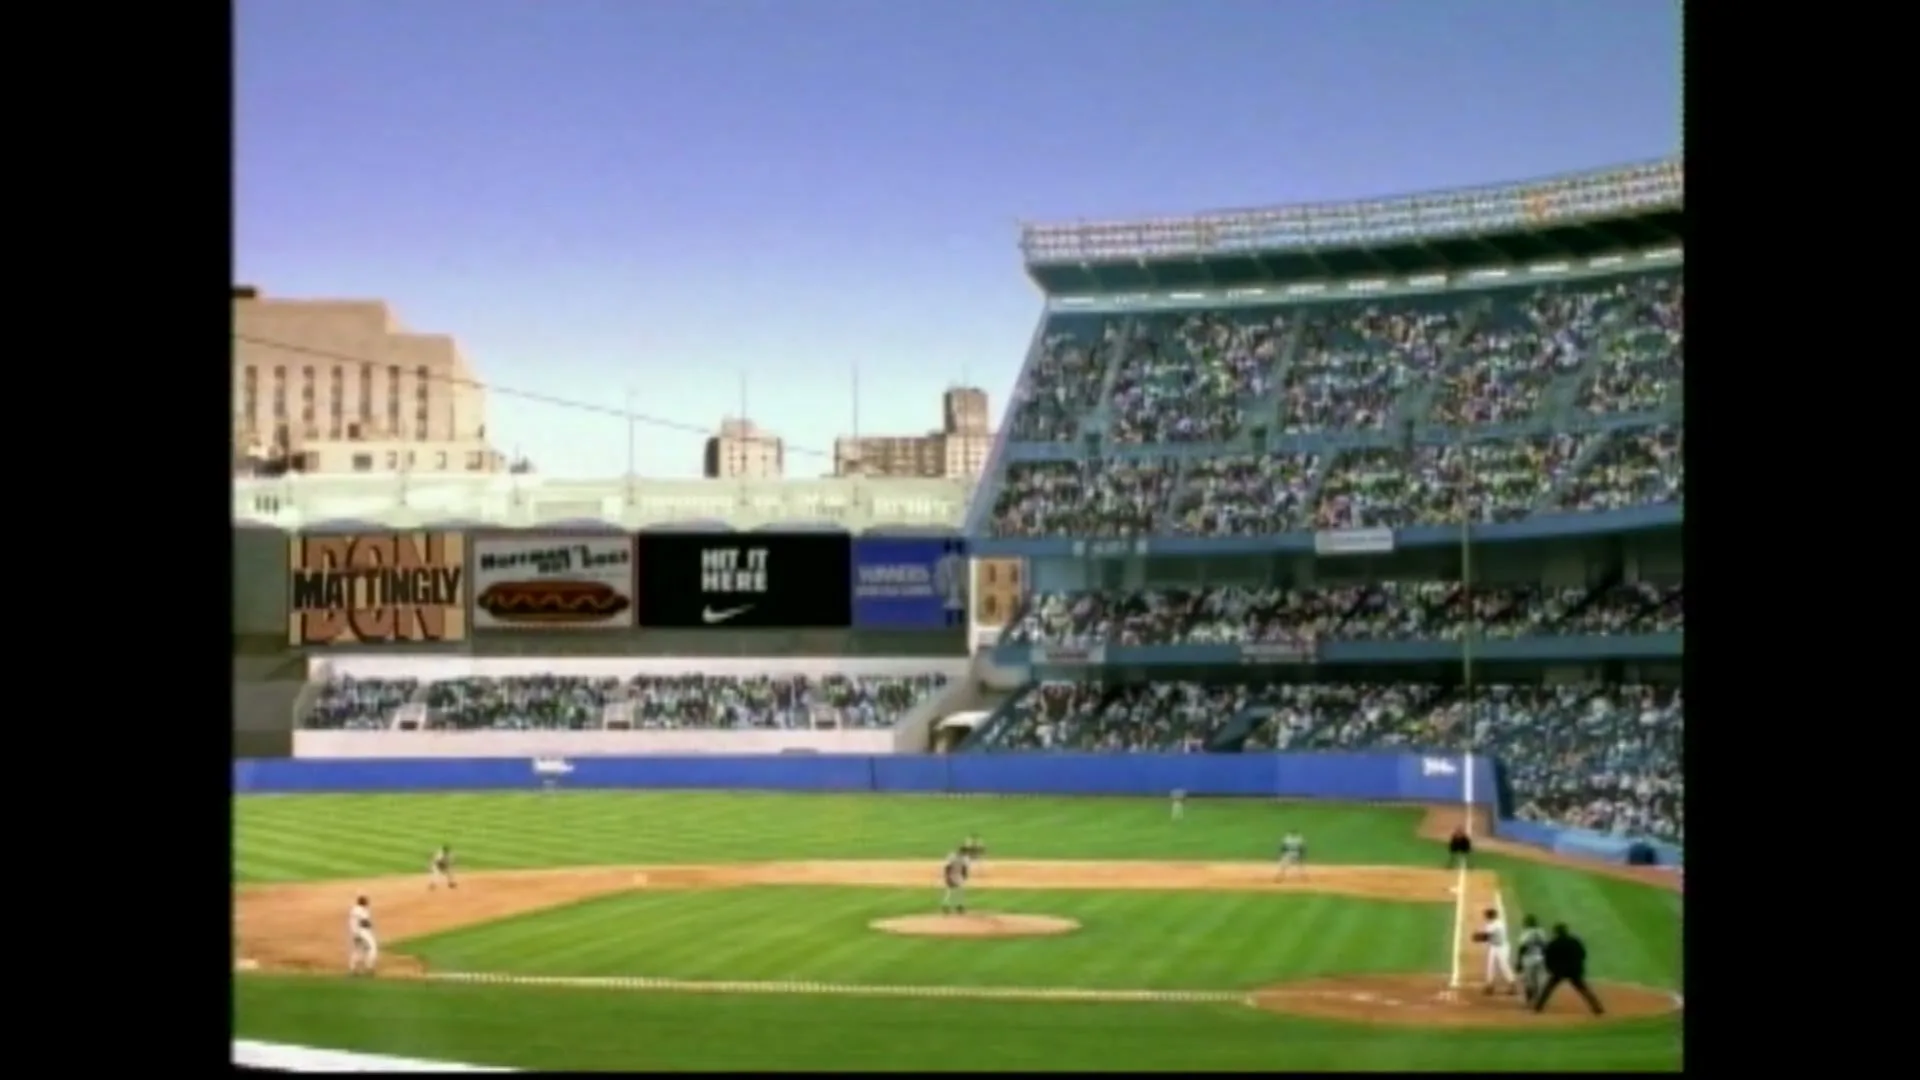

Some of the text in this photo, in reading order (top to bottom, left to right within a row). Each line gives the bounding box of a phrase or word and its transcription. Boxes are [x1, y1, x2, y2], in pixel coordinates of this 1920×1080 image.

[702, 548, 769, 570] HIT IT
[294, 567, 461, 609] MATTINGLY
[702, 571, 768, 592] HERE
